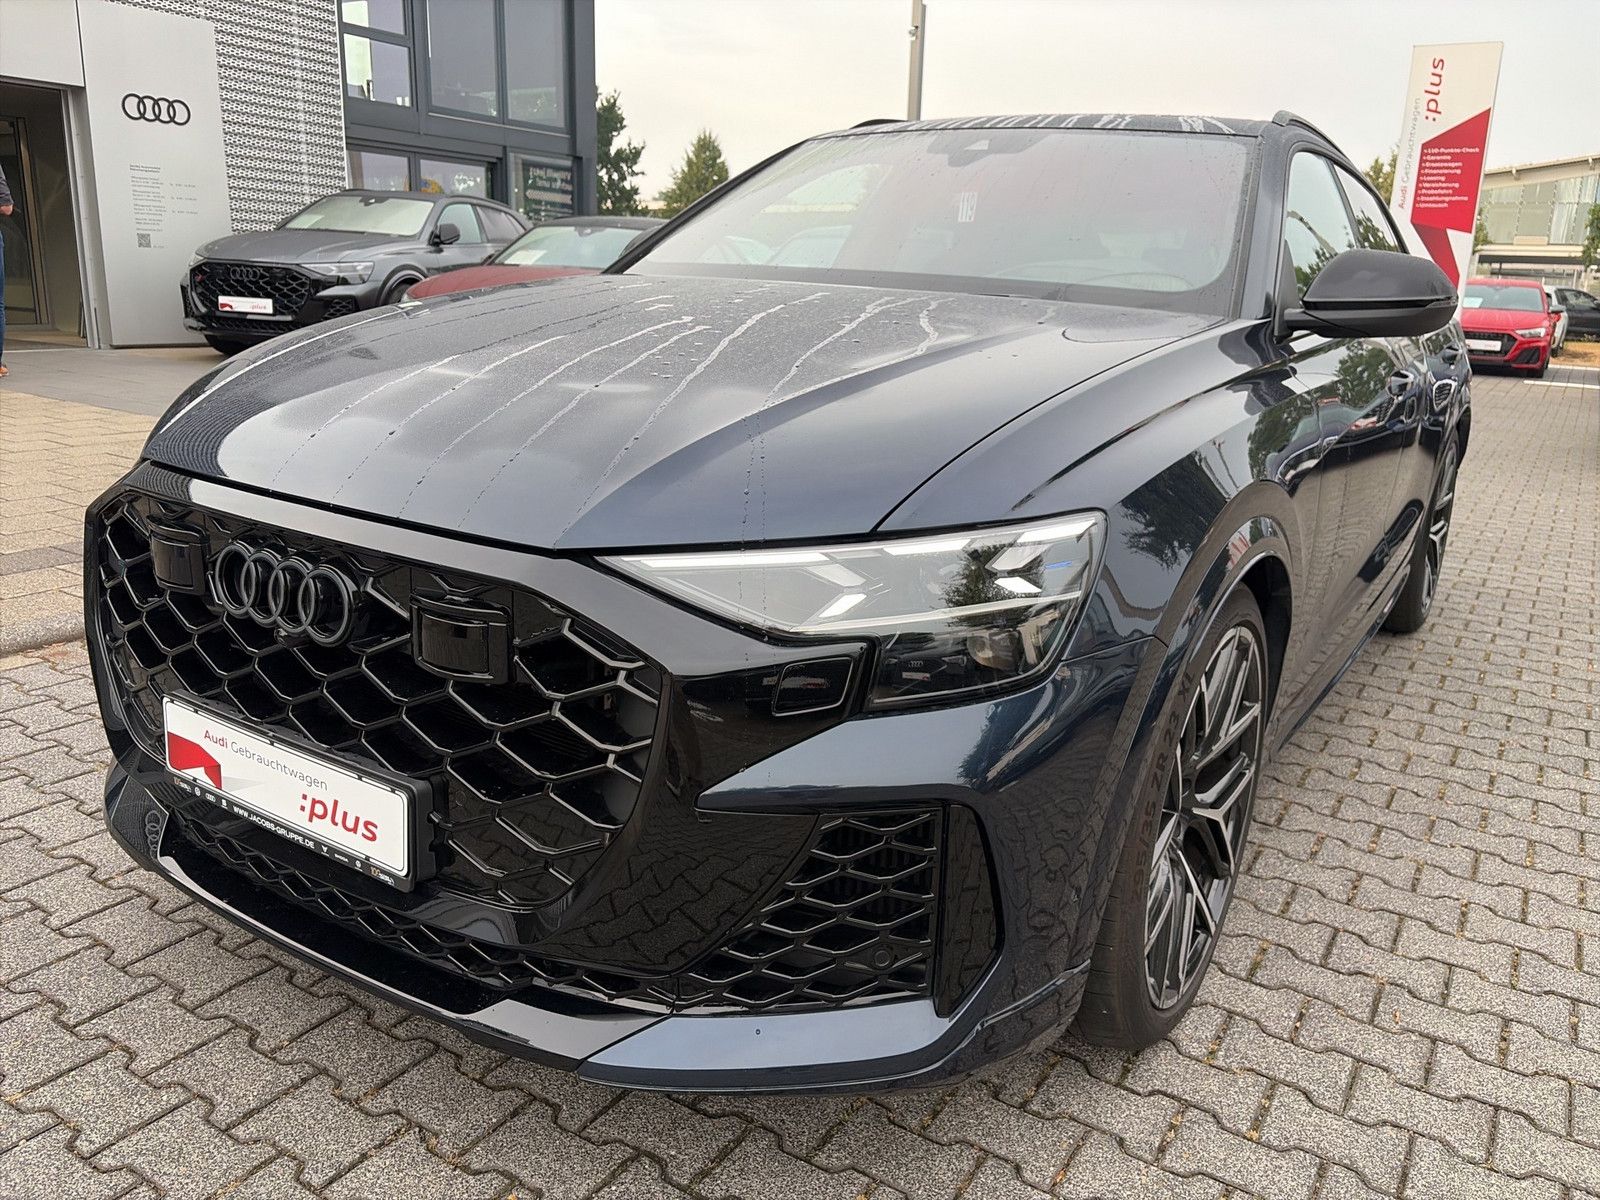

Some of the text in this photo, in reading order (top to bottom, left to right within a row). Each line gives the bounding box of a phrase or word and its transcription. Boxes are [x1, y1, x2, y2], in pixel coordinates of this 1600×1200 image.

[1424, 57, 1445, 122] :plus
[1398, 97, 1421, 209] Audi Gebrauchtwagen
[203, 729, 228, 749] Audi
[230, 741, 328, 791] Gebrauchtwagen
[1151, 752, 1169, 792] ZR
[1164, 710, 1181, 745] 23
[233, 806, 315, 849] WWW.JACOBS-GRUPPE.DE
[299, 793, 378, 842] :plus
